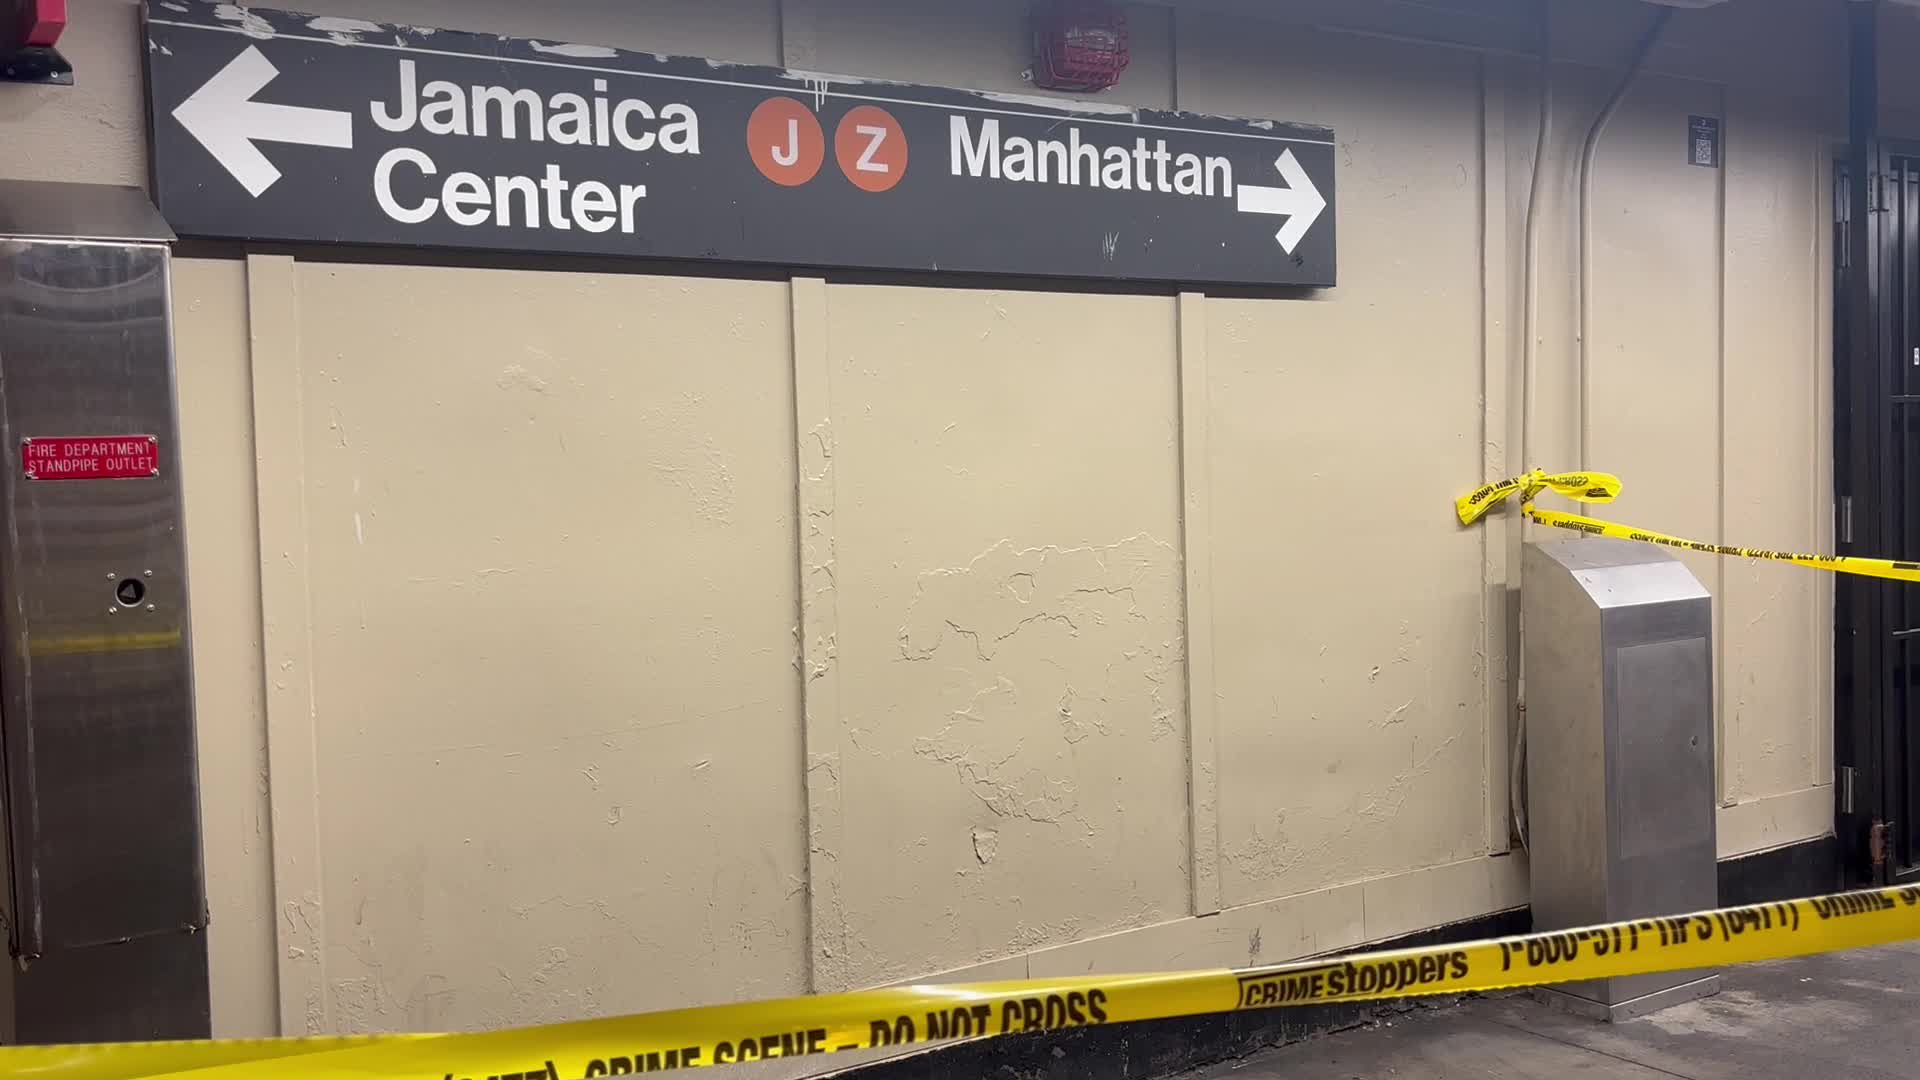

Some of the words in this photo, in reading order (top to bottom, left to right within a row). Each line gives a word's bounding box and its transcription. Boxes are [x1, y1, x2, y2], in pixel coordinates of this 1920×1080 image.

[370, 59, 701, 155] Jamaica
[771, 119, 799, 166] J
[856, 125, 889, 173] Z
[949, 114, 1233, 198] Manhattan
[373, 147, 647, 234] Center
[28, 444, 57, 457] FIRE
[64, 442, 150, 456] DEPARTMENT
[28, 459, 99, 473] STANDPIPE
[106, 457, 153, 470] OUTLET
[926, 1004, 991, 1042] NOT
[1001, 989, 1108, 1035] CROSS
